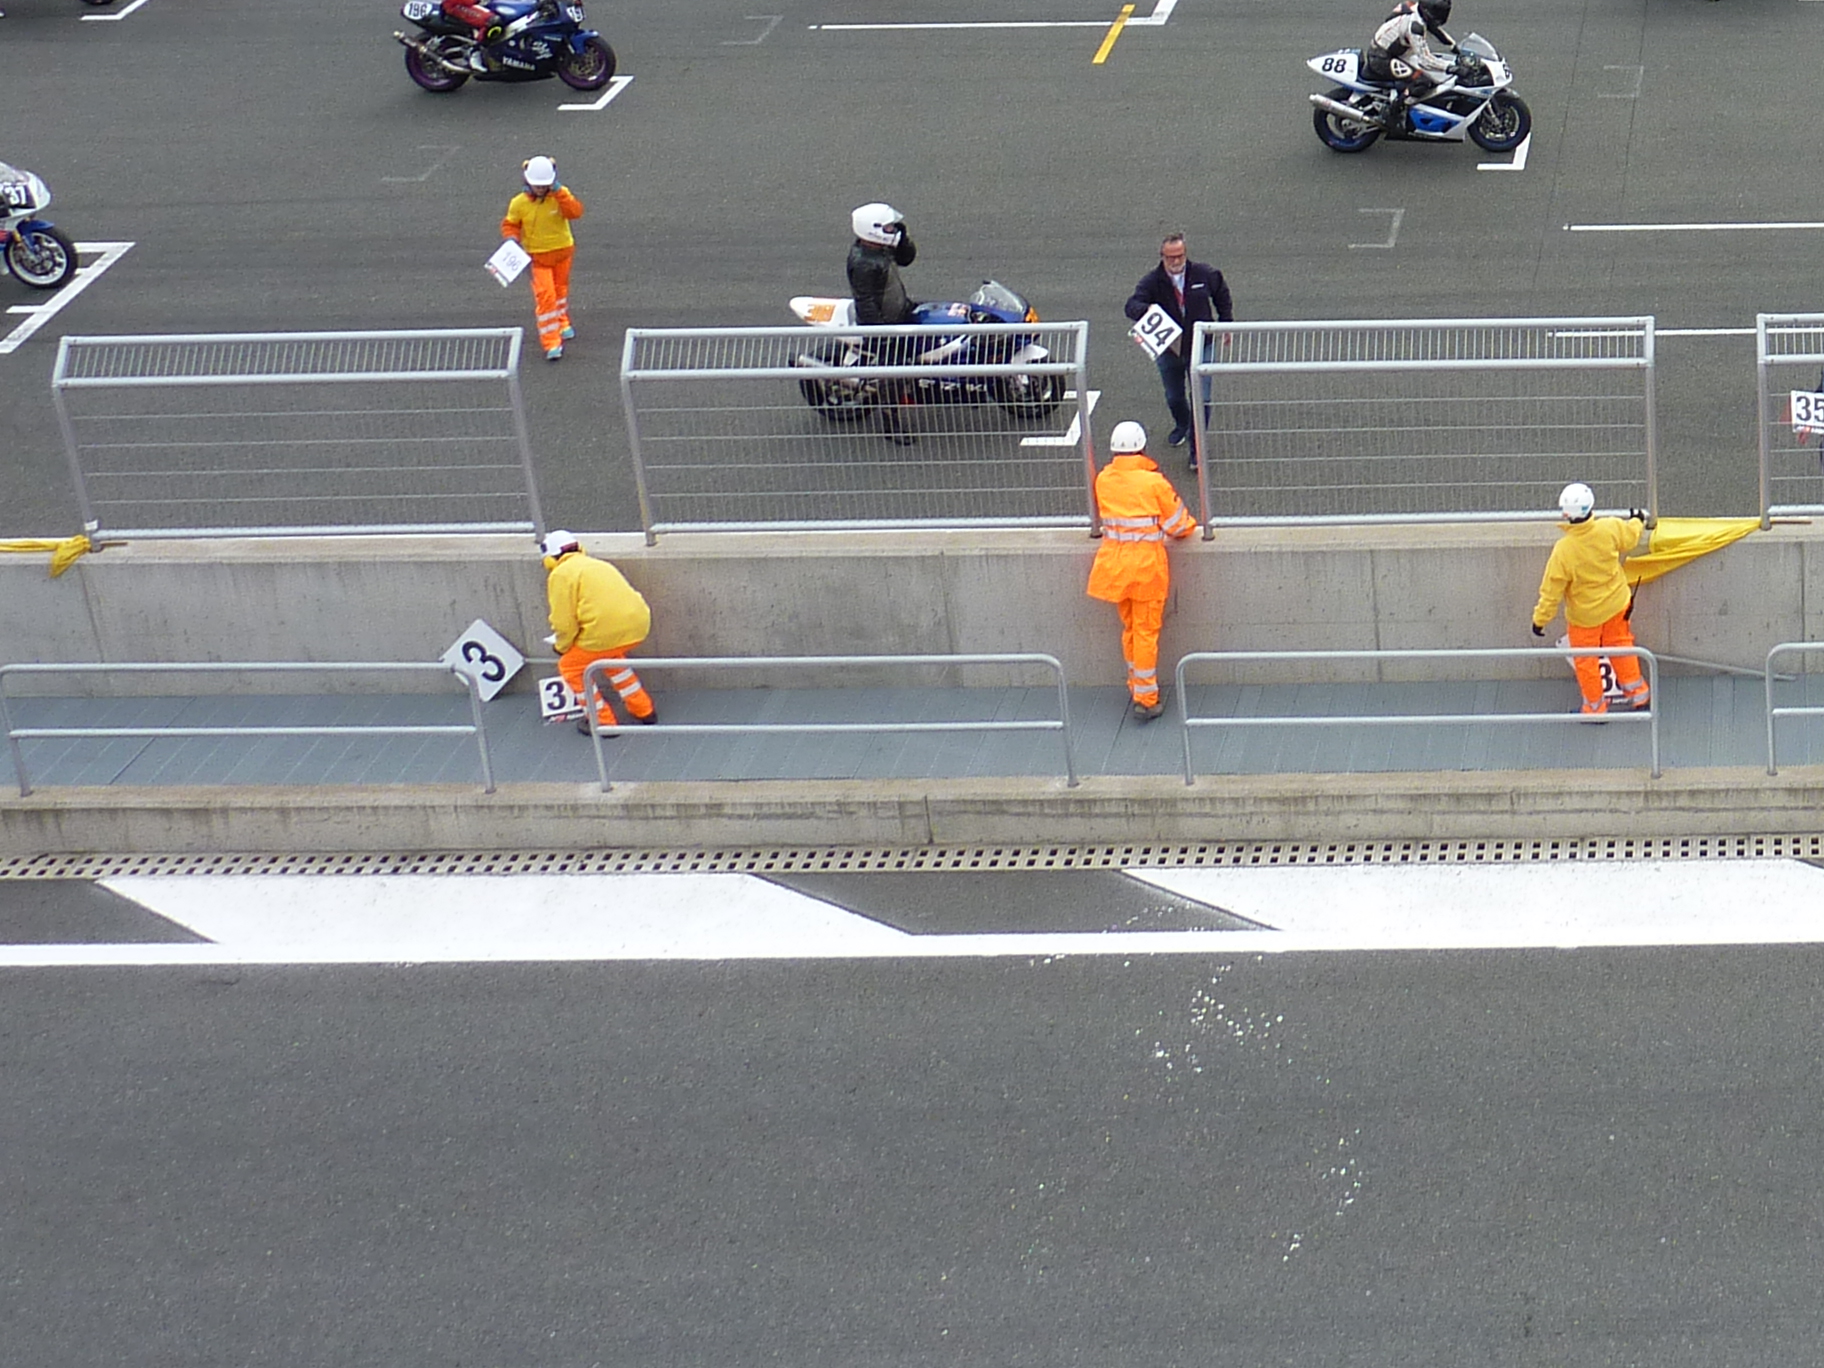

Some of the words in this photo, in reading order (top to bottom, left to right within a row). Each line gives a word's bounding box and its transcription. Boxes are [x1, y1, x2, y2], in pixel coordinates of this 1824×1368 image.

[502, 56, 536, 71] YAMAHA
[1321, 57, 1348, 74] 88
[503, 251, 522, 272] 196
[1141, 312, 1176, 348] 94
[461, 640, 506, 682] 3
